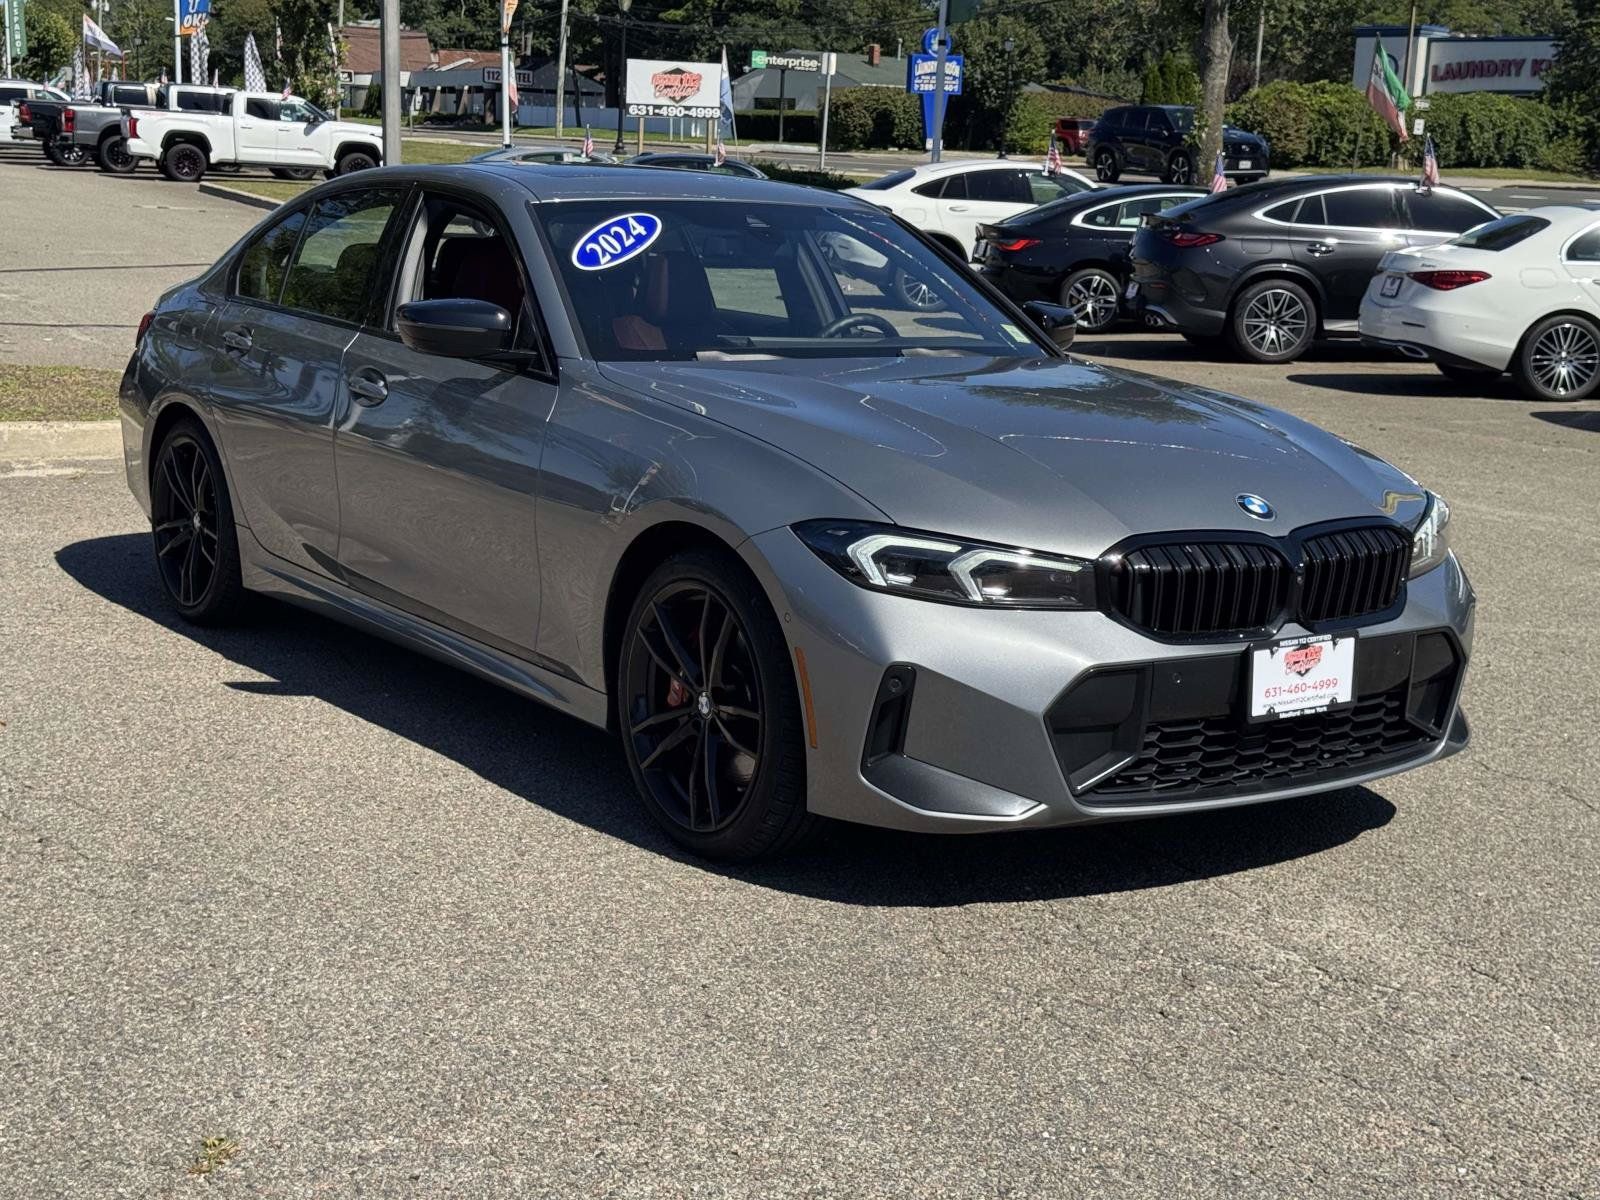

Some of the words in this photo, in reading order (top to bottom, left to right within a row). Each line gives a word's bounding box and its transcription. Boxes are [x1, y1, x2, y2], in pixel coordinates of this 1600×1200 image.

[756, 55, 818, 68] enterprise
[1431, 58, 1527, 82] LAUNDRY
[486, 70, 500, 81] 112
[628, 105, 720, 118] 631-490-4999
[585, 216, 647, 265] 2024
[1264, 678, 1338, 699] 631-460-4999
